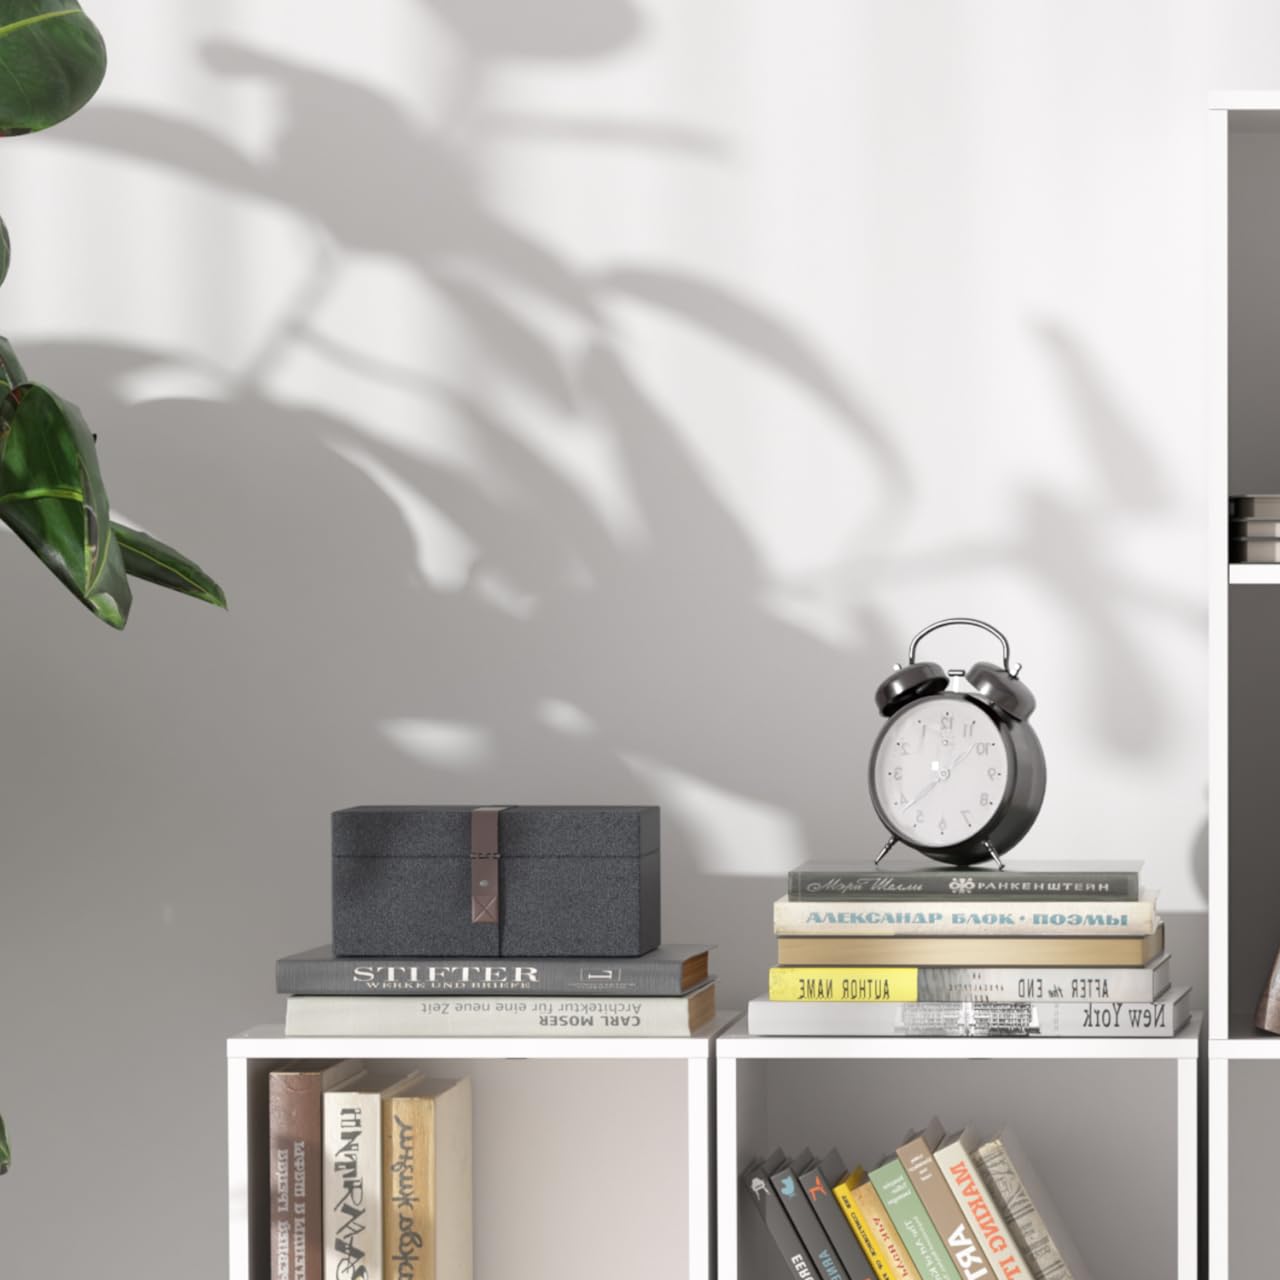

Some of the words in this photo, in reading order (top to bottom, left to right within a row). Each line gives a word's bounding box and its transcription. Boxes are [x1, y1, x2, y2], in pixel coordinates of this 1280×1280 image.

[807, 912, 943, 927] АЛЕКСАНДР
[952, 912, 1015, 927] БЛОК
[1032, 912, 1128, 927] ПОЭМЫ
[353, 967, 540, 983] STIFTER
[421, 1002, 449, 1015] Zeit
[455, 1002, 490, 1015] neue
[495, 1002, 527, 1015] eine
[532, 1002, 553, 1015] für
[557, 1002, 642, 1015] Architektur
[539, 1015, 593, 1027] MOSER
[604, 1015, 641, 1027] CARL
